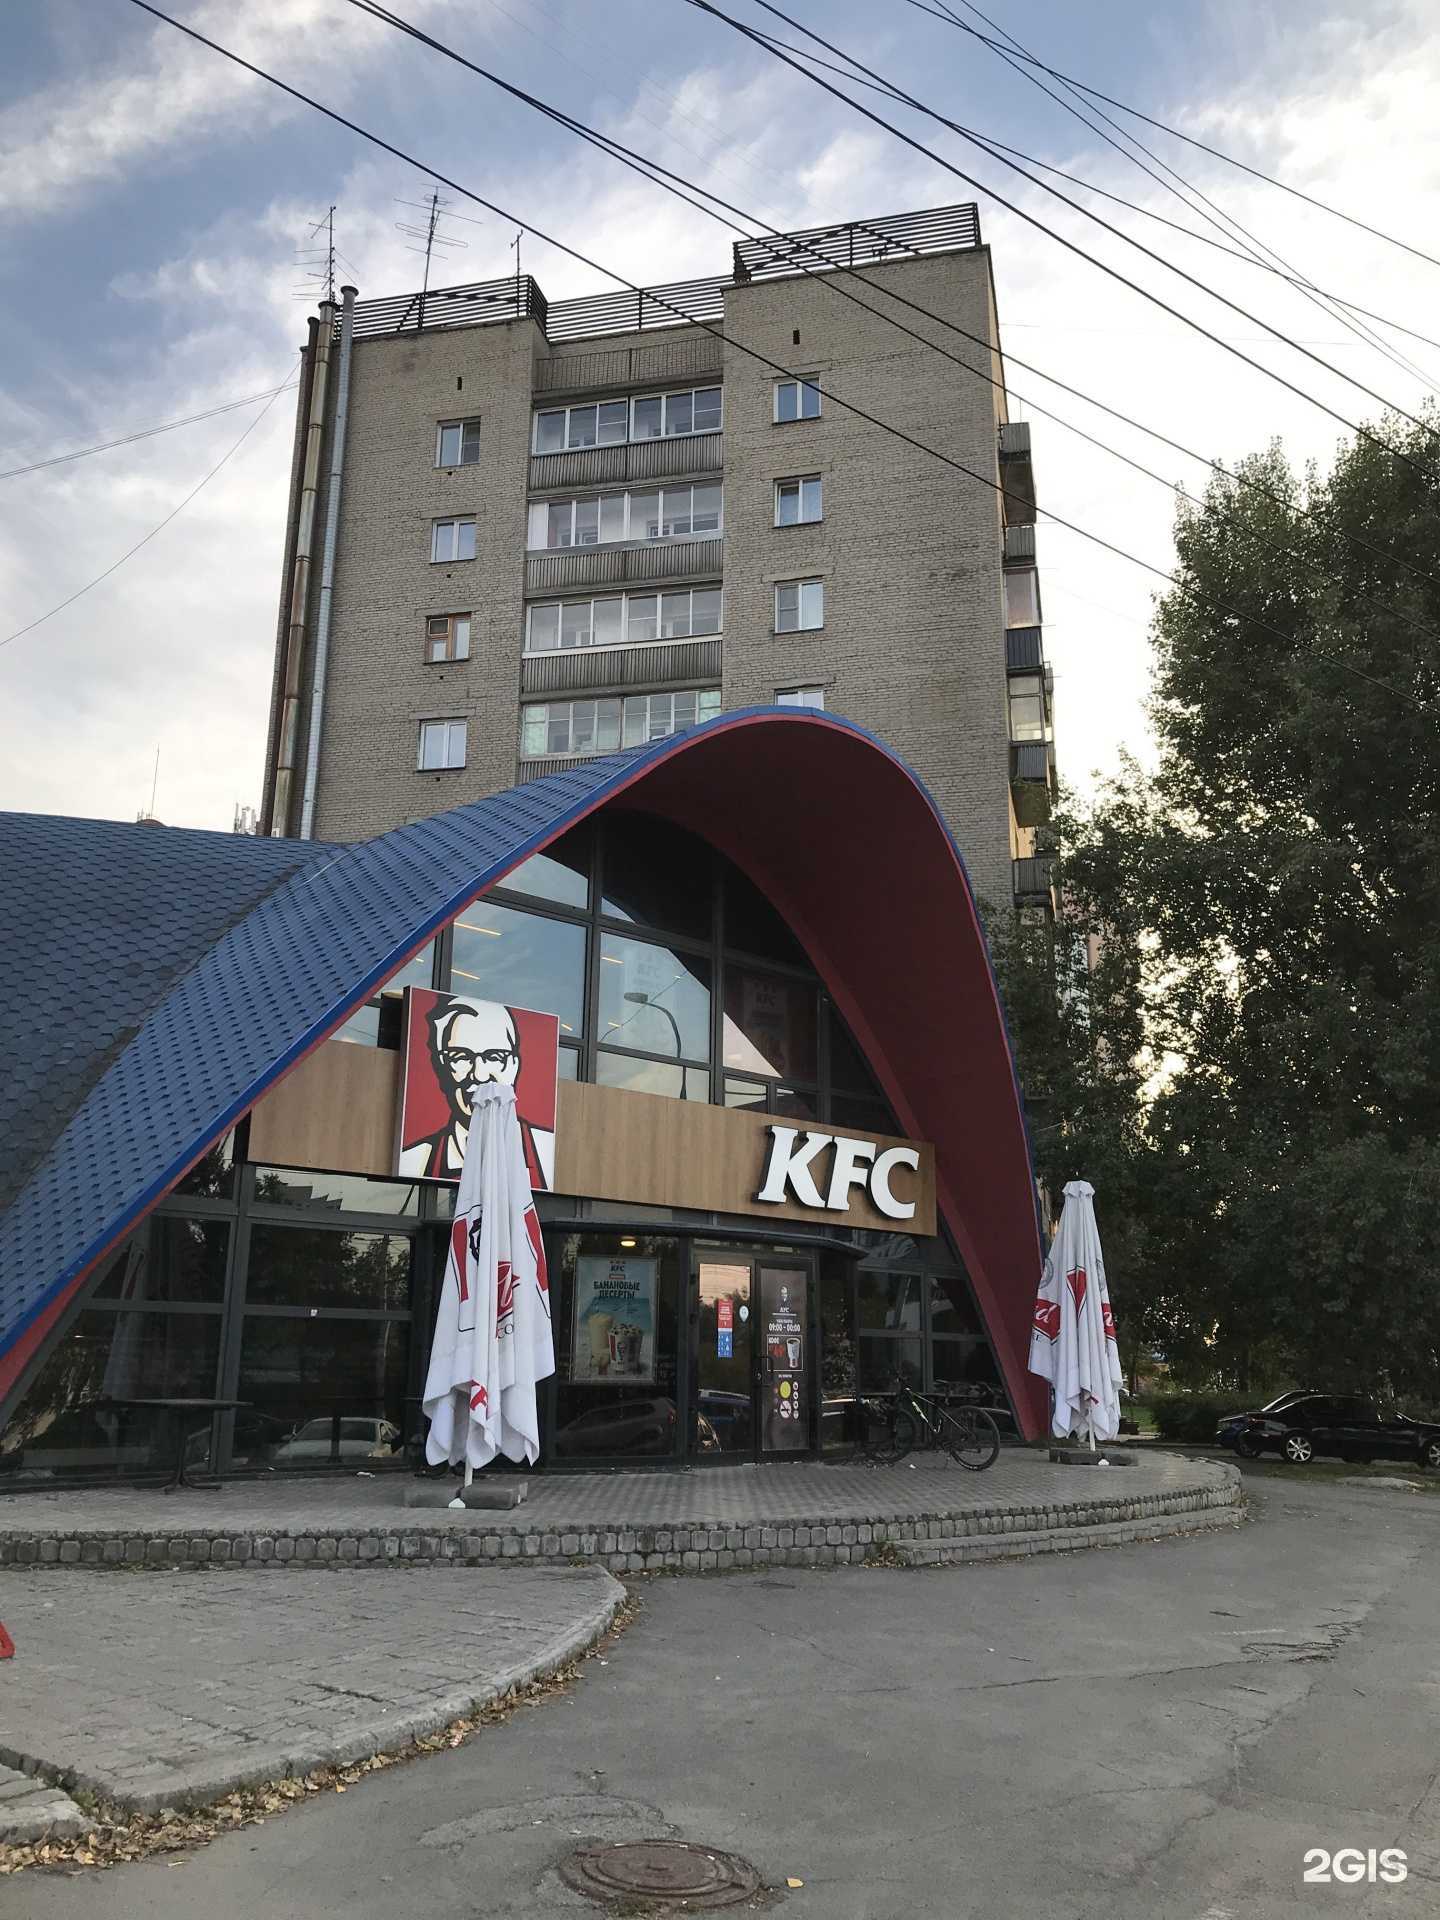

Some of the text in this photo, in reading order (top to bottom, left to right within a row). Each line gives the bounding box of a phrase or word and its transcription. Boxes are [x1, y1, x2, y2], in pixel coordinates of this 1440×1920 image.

[757, 1125, 920, 1219] KFC
[593, 1280, 641, 1290] БАНАНОВЫЕ
[599, 1290, 635, 1300] ДЕСЕРТЫ
